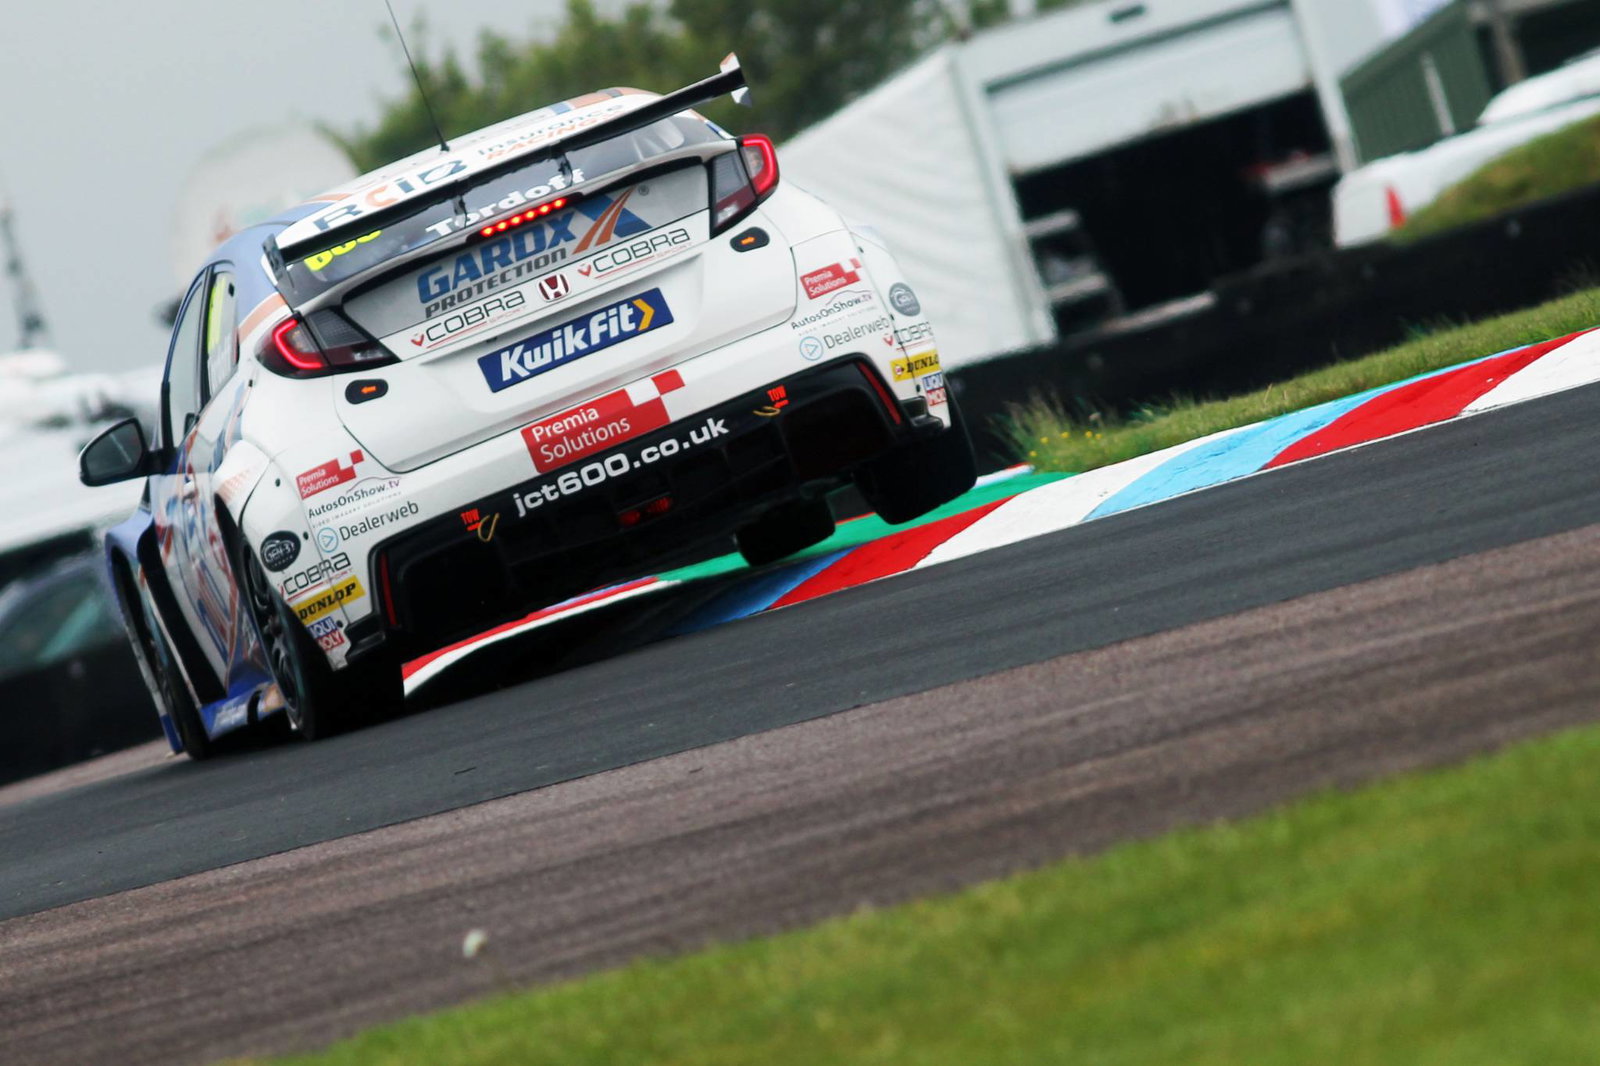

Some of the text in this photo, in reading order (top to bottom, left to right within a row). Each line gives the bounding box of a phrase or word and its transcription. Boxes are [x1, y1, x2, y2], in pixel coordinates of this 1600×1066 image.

[478, 104, 623, 156] Insurance
[425, 167, 585, 236] Tordoff
[425, 248, 567, 318] PROTECTION
[823, 315, 890, 349] Dealerweb
[907, 354, 940, 373] DUNLO
[767, 385, 787, 402] TOW
[531, 406, 600, 442] Premia
[540, 417, 631, 463] Solutions
[298, 467, 327, 485] Premia
[512, 416, 730, 517] jct600.co.uk
[301, 474, 340, 496] Solutions
[308, 479, 400, 518] AutosOnShow.tv
[339, 500, 419, 541] Dealerweb
[460, 508, 480, 525] TOW
[298, 582, 356, 619] DUNLOP
[309, 617, 336, 638] IQUI
